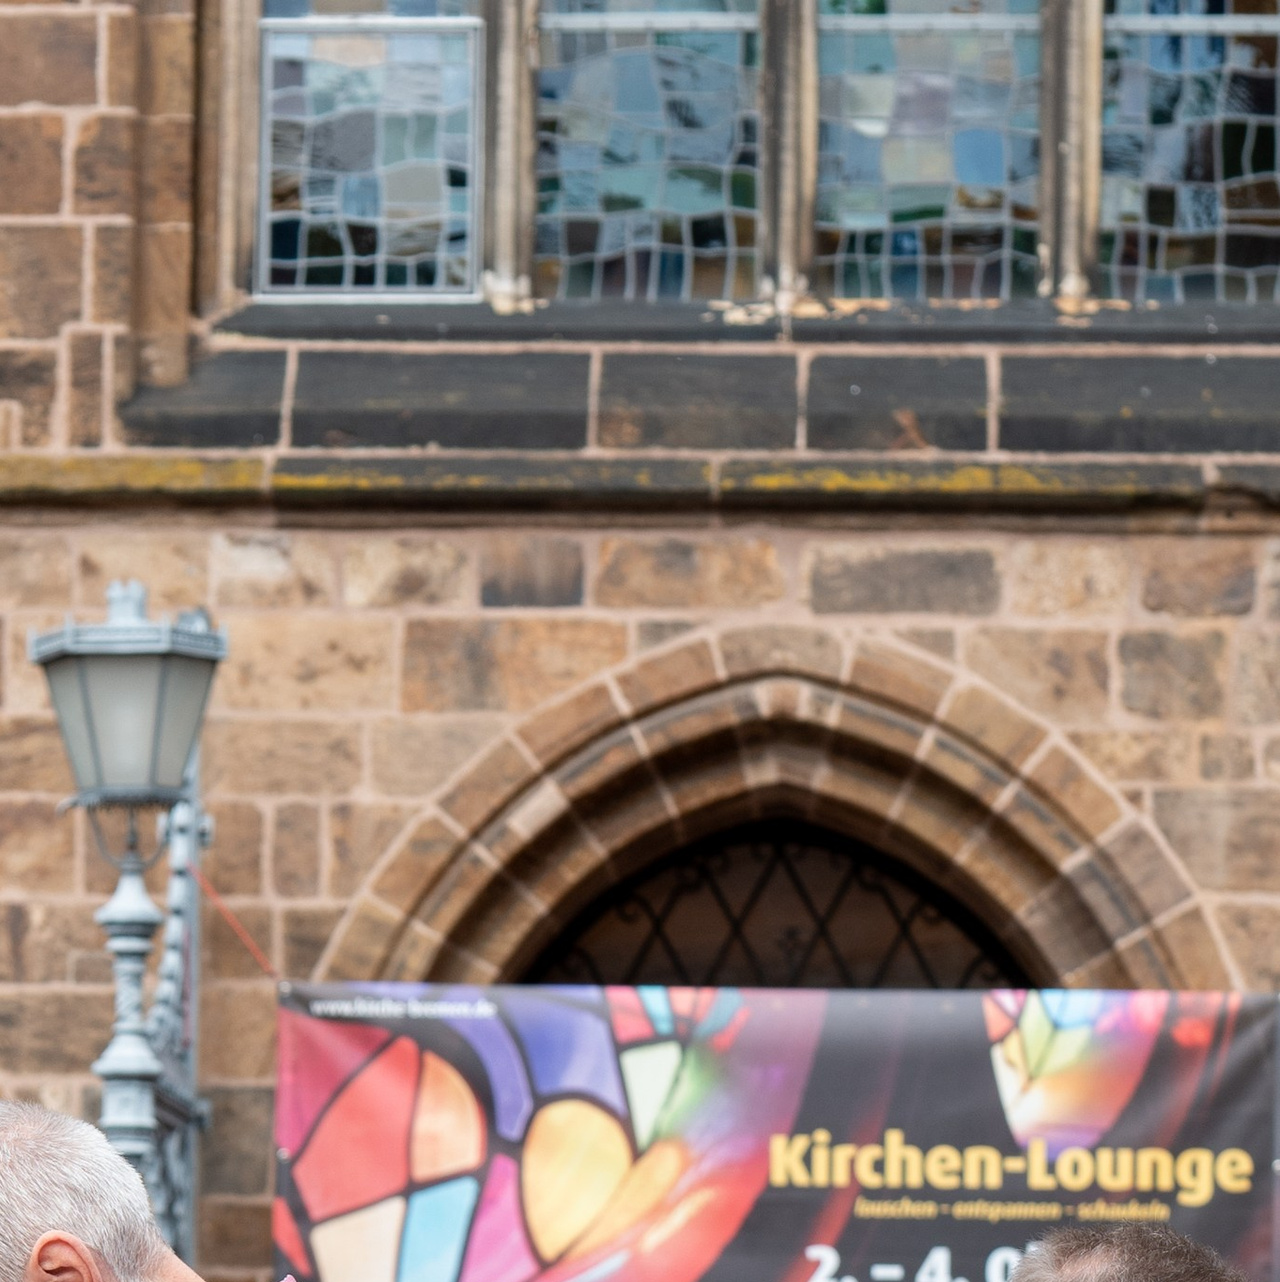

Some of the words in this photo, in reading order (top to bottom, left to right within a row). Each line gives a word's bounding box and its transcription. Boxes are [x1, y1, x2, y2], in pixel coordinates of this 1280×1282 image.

[768, 1128, 1255, 1208] Kirchen-Lounge
[853, 1194, 939, 1220] lauschen
[951, 1198, 1063, 1225] entspannen
